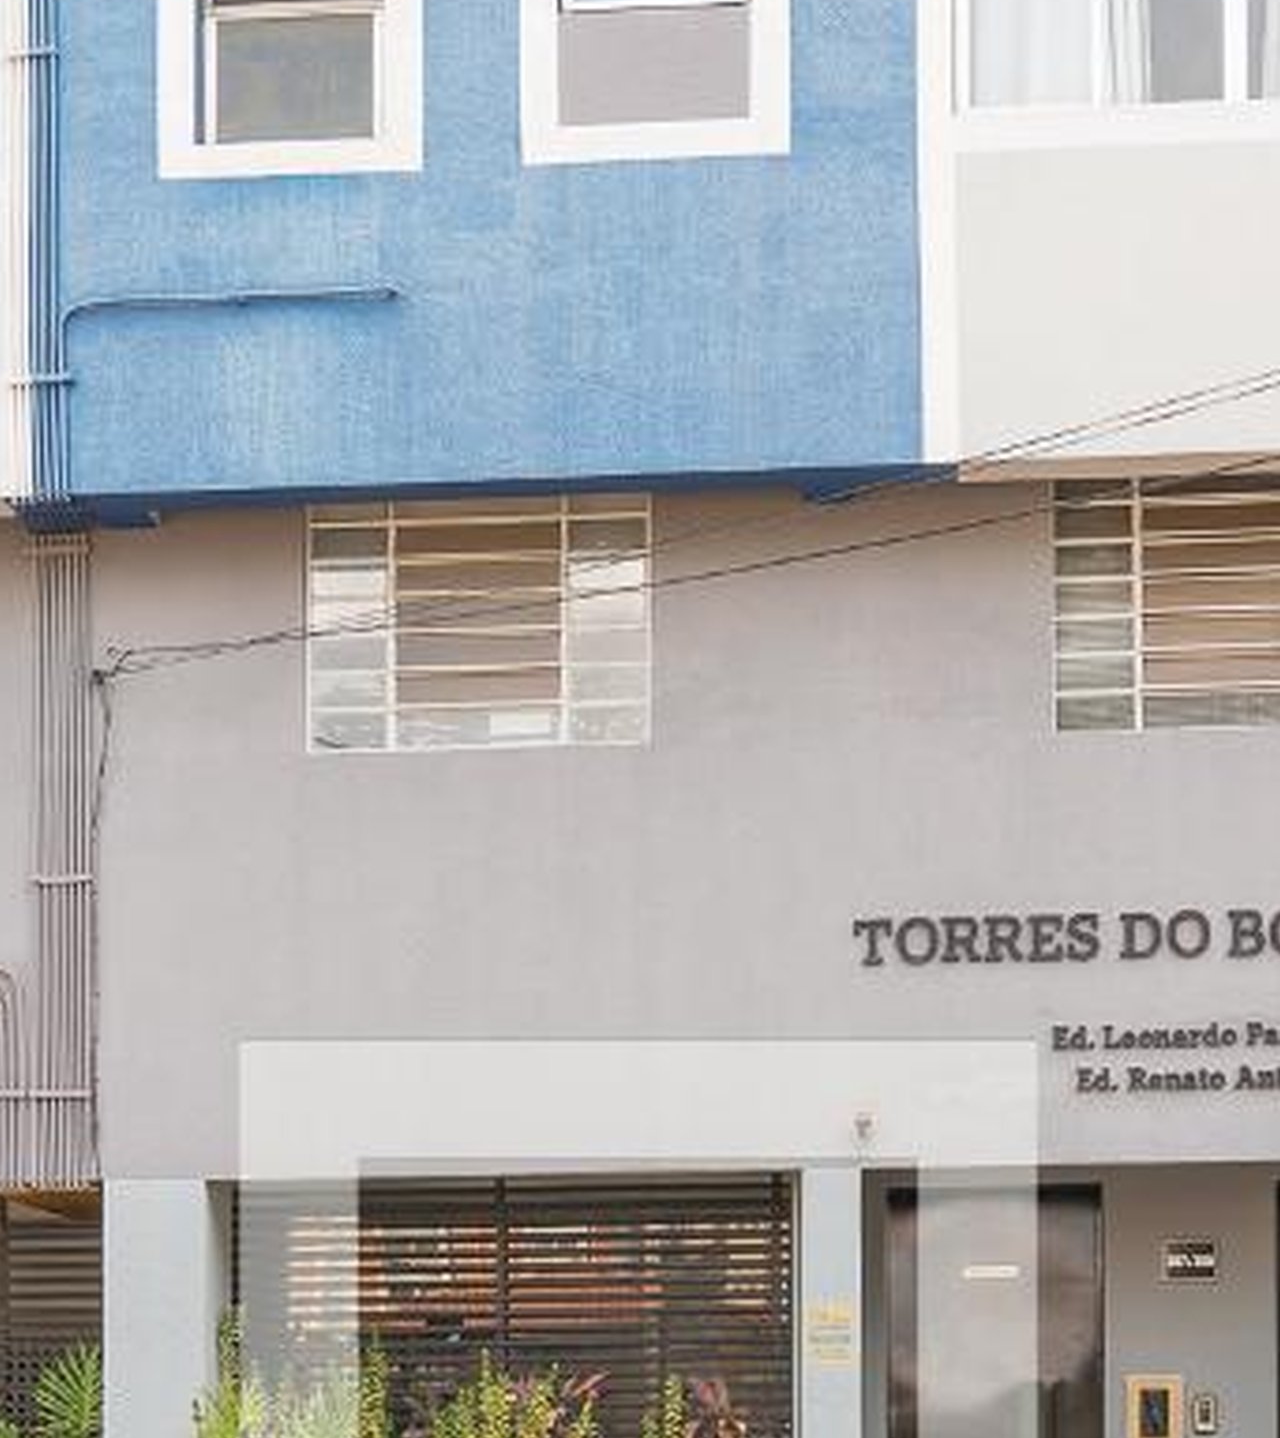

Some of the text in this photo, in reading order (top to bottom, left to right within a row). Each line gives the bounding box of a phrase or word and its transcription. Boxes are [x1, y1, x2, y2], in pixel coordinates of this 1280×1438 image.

[853, 912, 1100, 967] TORRES
[1120, 909, 1211, 960] DO
[1052, 1024, 1095, 1051] Ed.
[1102, 1021, 1237, 1050] Leonardo
[1076, 1066, 1118, 1093] Ed.
[1127, 1065, 1226, 1093] Renato
